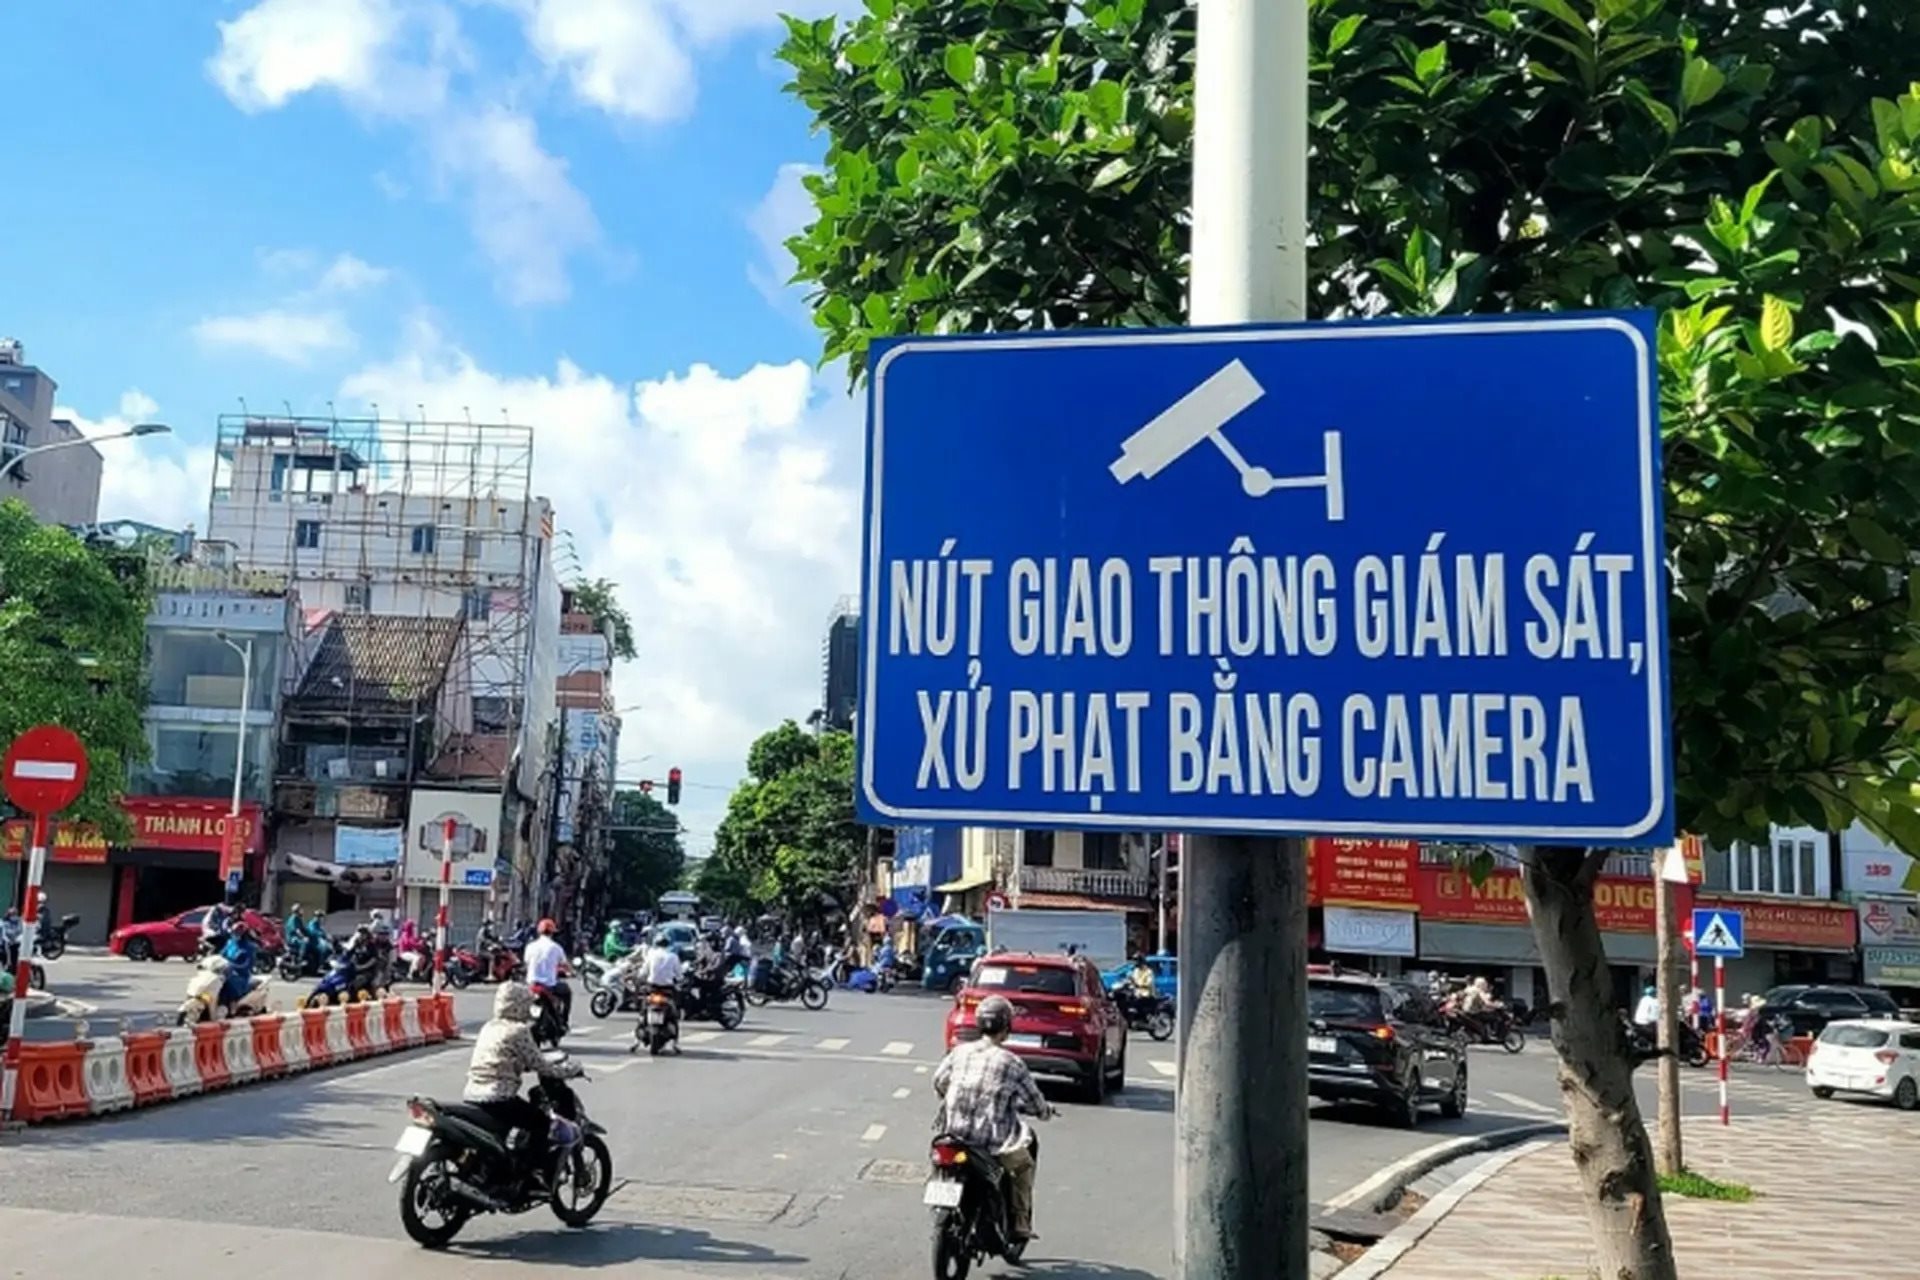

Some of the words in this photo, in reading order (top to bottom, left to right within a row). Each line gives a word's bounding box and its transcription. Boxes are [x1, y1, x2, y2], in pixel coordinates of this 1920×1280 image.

[889, 538, 993, 656] NÚT
[1009, 557, 1132, 657] GIAO
[1149, 536, 1337, 657] THÔNG
[1354, 532, 1507, 658] GIÁM
[1524, 532, 1643, 674] SÁT,
[916, 657, 992, 790] XỬ
[1008, 690, 1150, 811] PHẠT
[1169, 656, 1321, 797] BẰNG
[1342, 693, 1594, 803] CAMERA
